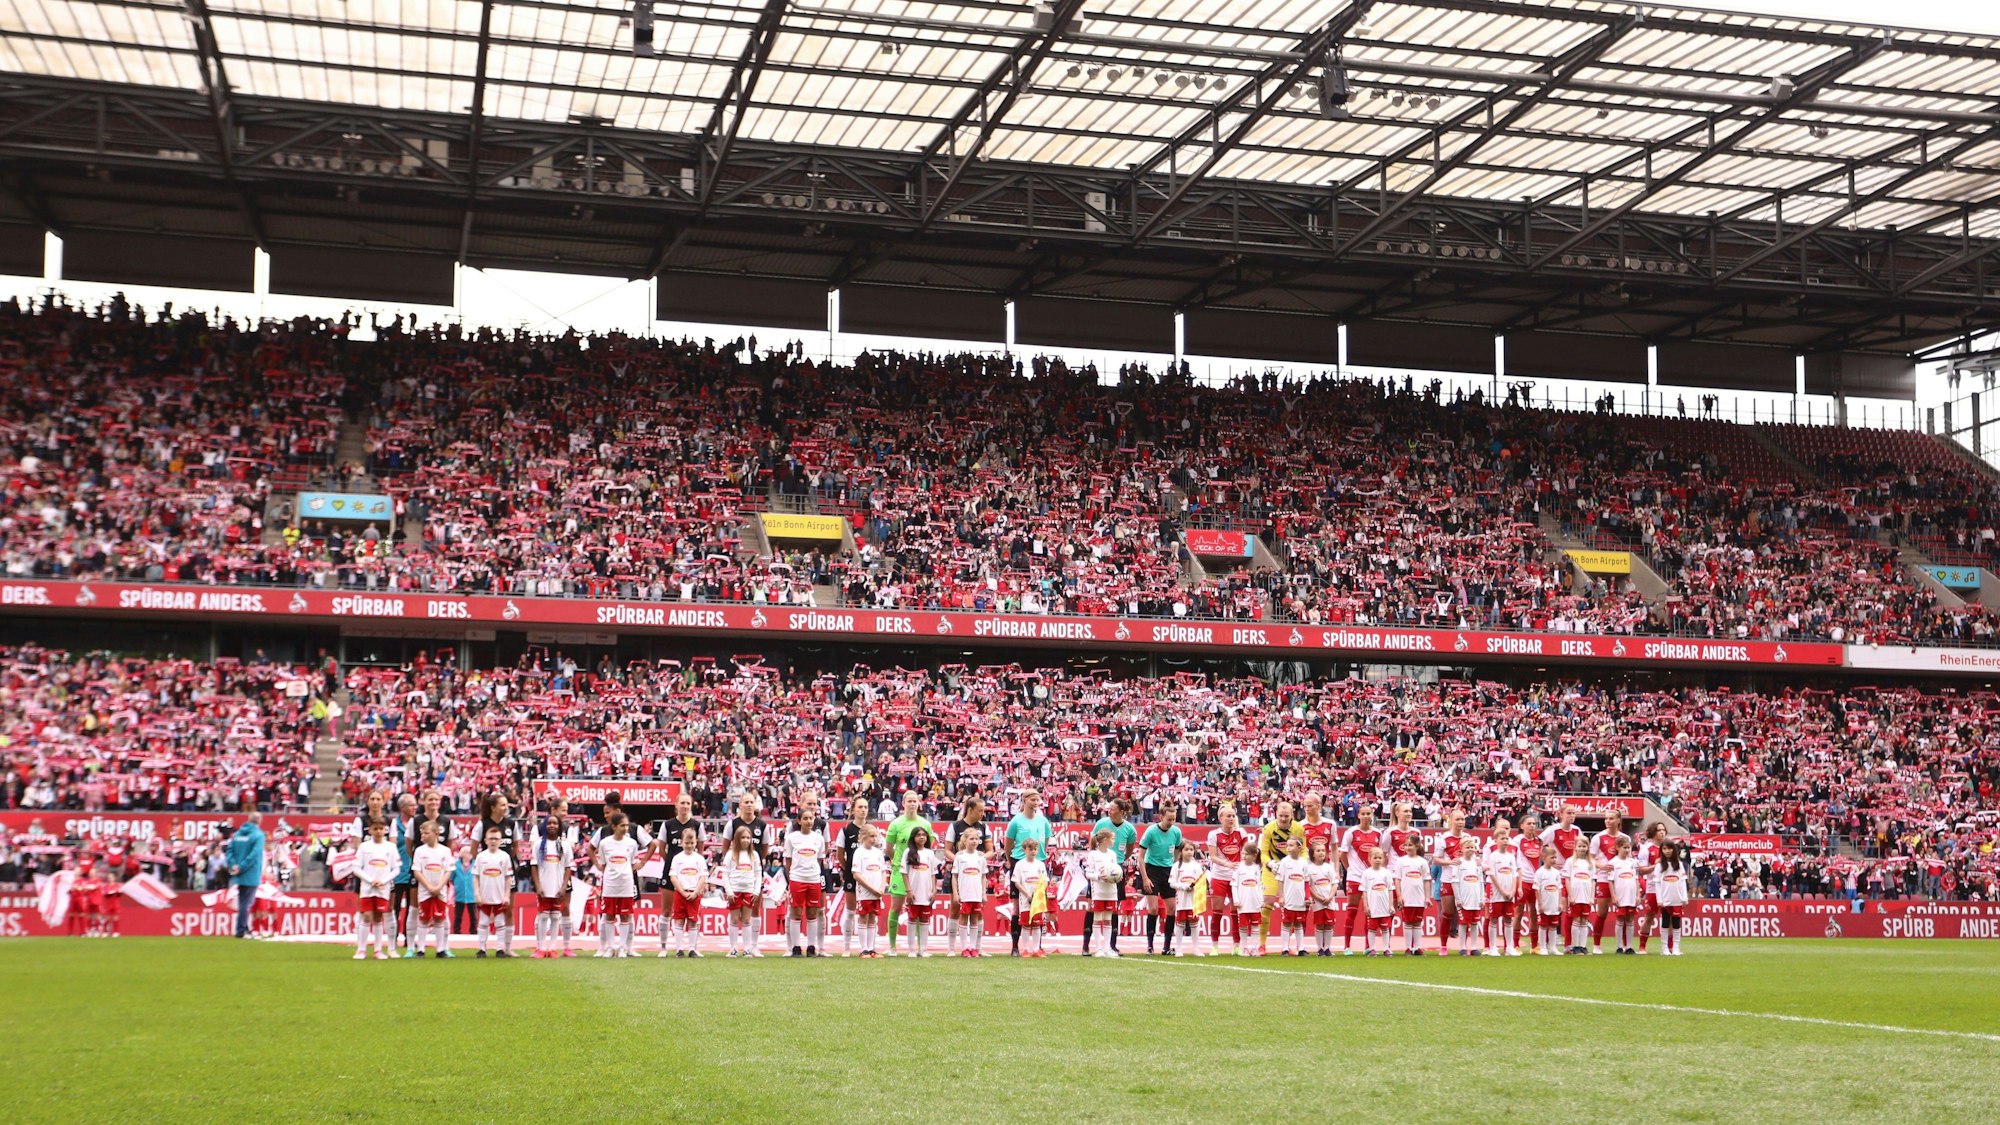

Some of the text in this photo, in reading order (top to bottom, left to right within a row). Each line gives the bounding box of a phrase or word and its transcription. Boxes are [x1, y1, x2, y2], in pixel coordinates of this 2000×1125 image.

[763, 519, 840, 531] Köln Bonn Airport
[1227, 545, 1238, 553] FC
[1581, 556, 1599, 564] Bonn
[1600, 556, 1628, 566] Airport
[119, 588, 267, 612] SPÜRBAR ANDERS.
[331, 595, 404, 616] SPÜRBAR
[597, 604, 729, 627] SPÜRBAR ANDERS.
[789, 611, 854, 631] SPÜRBAR
[974, 618, 1096, 639] SPÜRBAR ANDERS.
[1152, 624, 1213, 643] SPÜRBAR
[1322, 630, 1436, 651] SPÜRBAR ANDERS.
[1486, 636, 1543, 654] SPÜRBAR
[1644, 641, 1751, 661] SPÜRBAR ANDERS.
[565, 785, 671, 802] SPÜRB ANDERS.
[1696, 839, 1774, 850] 1. Frauenfanclub
[1717, 917, 1786, 937] ANDERS.
[1882, 914, 1935, 938] SPÜRB
